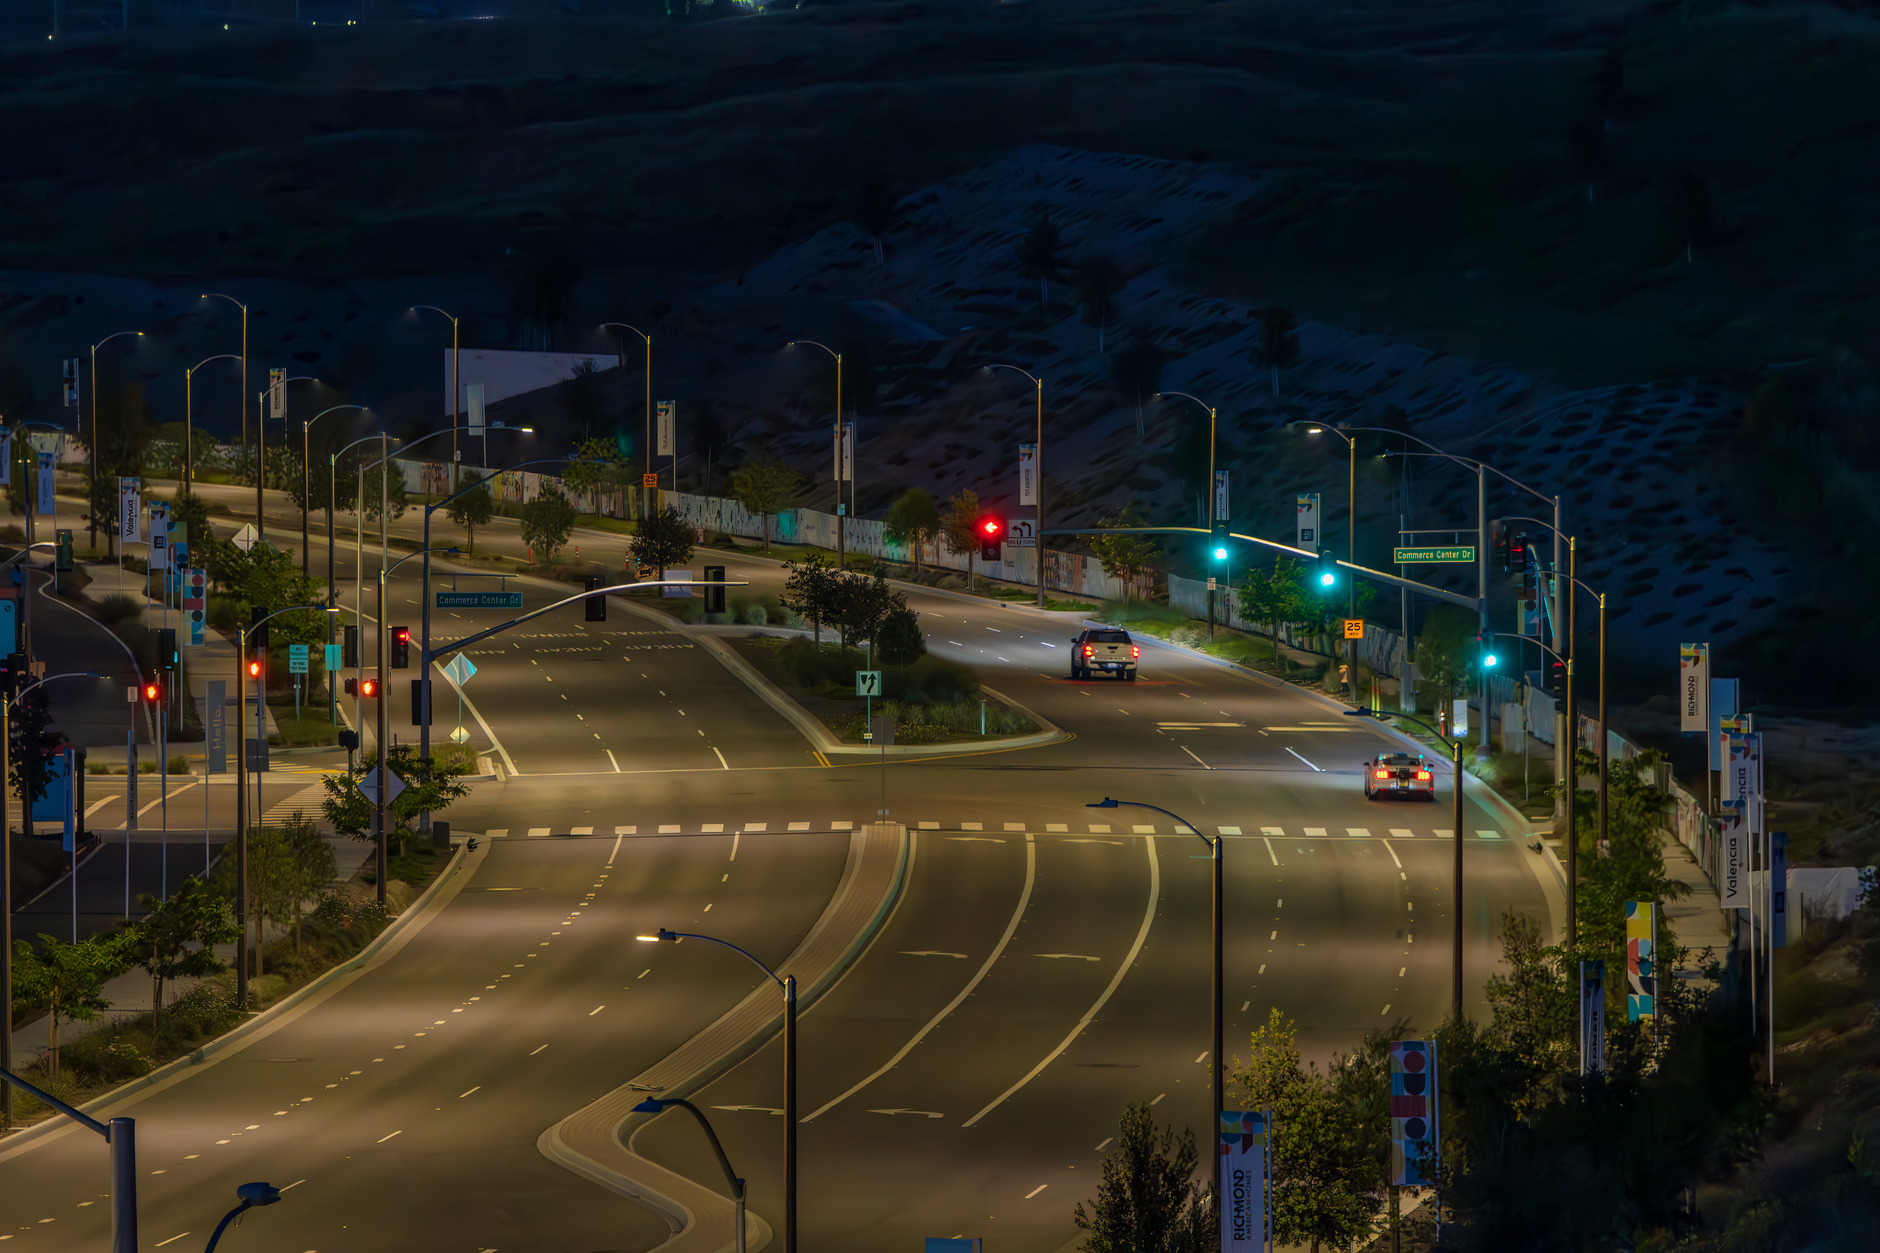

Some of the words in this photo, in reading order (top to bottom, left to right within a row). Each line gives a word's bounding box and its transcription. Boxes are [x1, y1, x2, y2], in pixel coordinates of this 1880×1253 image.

[1397, 551, 1434, 559] Commerce
[1436, 550, 1460, 559] Center
[1462, 550, 1471, 558] Dr
[439, 596, 478, 604] Commerce
[481, 595, 507, 604] Center
[1347, 622, 1361, 631] 25
[1738, 766, 1747, 800] encia
[1726, 837, 1737, 899] Valencia
[1233, 1169, 1245, 1241] RICHMOND
